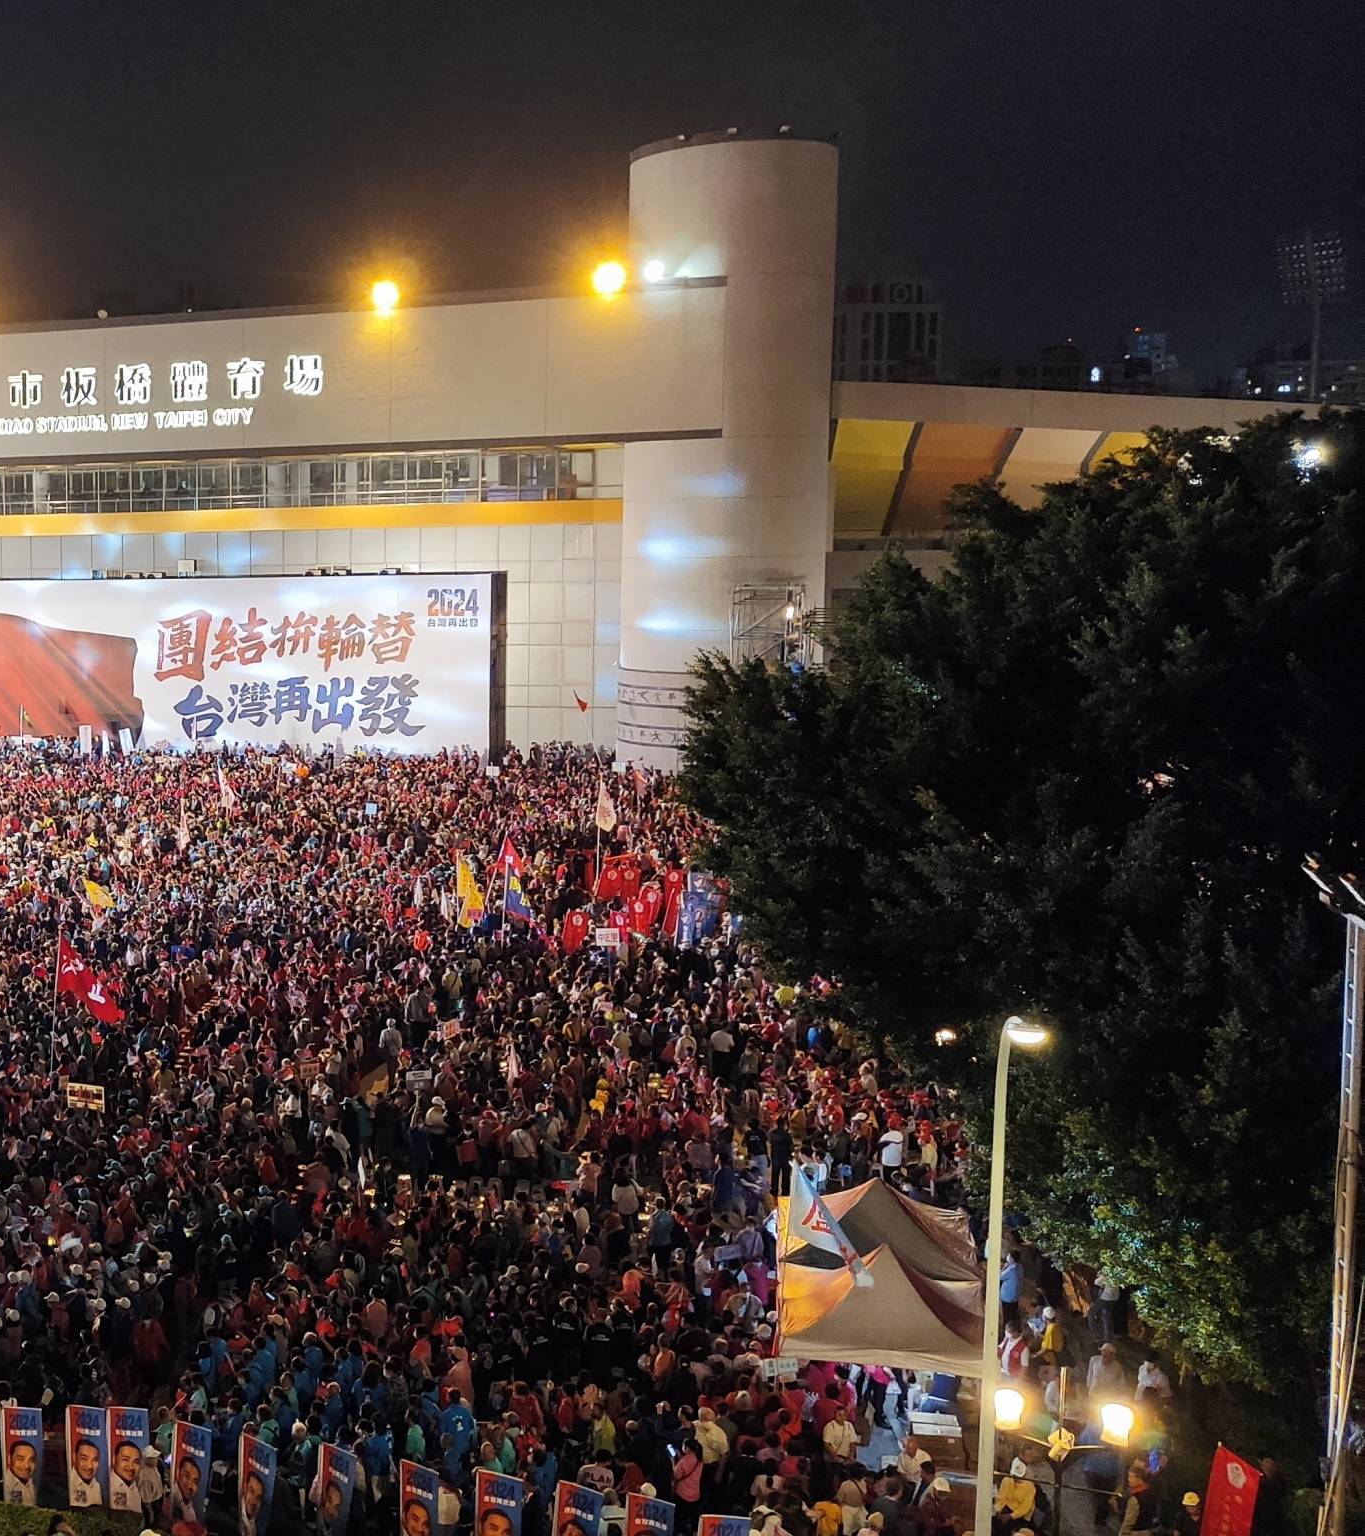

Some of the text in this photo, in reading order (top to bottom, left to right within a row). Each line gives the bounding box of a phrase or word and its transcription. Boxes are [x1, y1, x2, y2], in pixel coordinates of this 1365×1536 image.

[111, 412, 148, 431] NEW
[153, 409, 208, 429] TAIPEI
[213, 406, 254, 427] CITY
[427, 588, 479, 616] 2024
[173, 674, 427, 740] 台灣再出發
[484, 1479, 515, 1498] 2024
